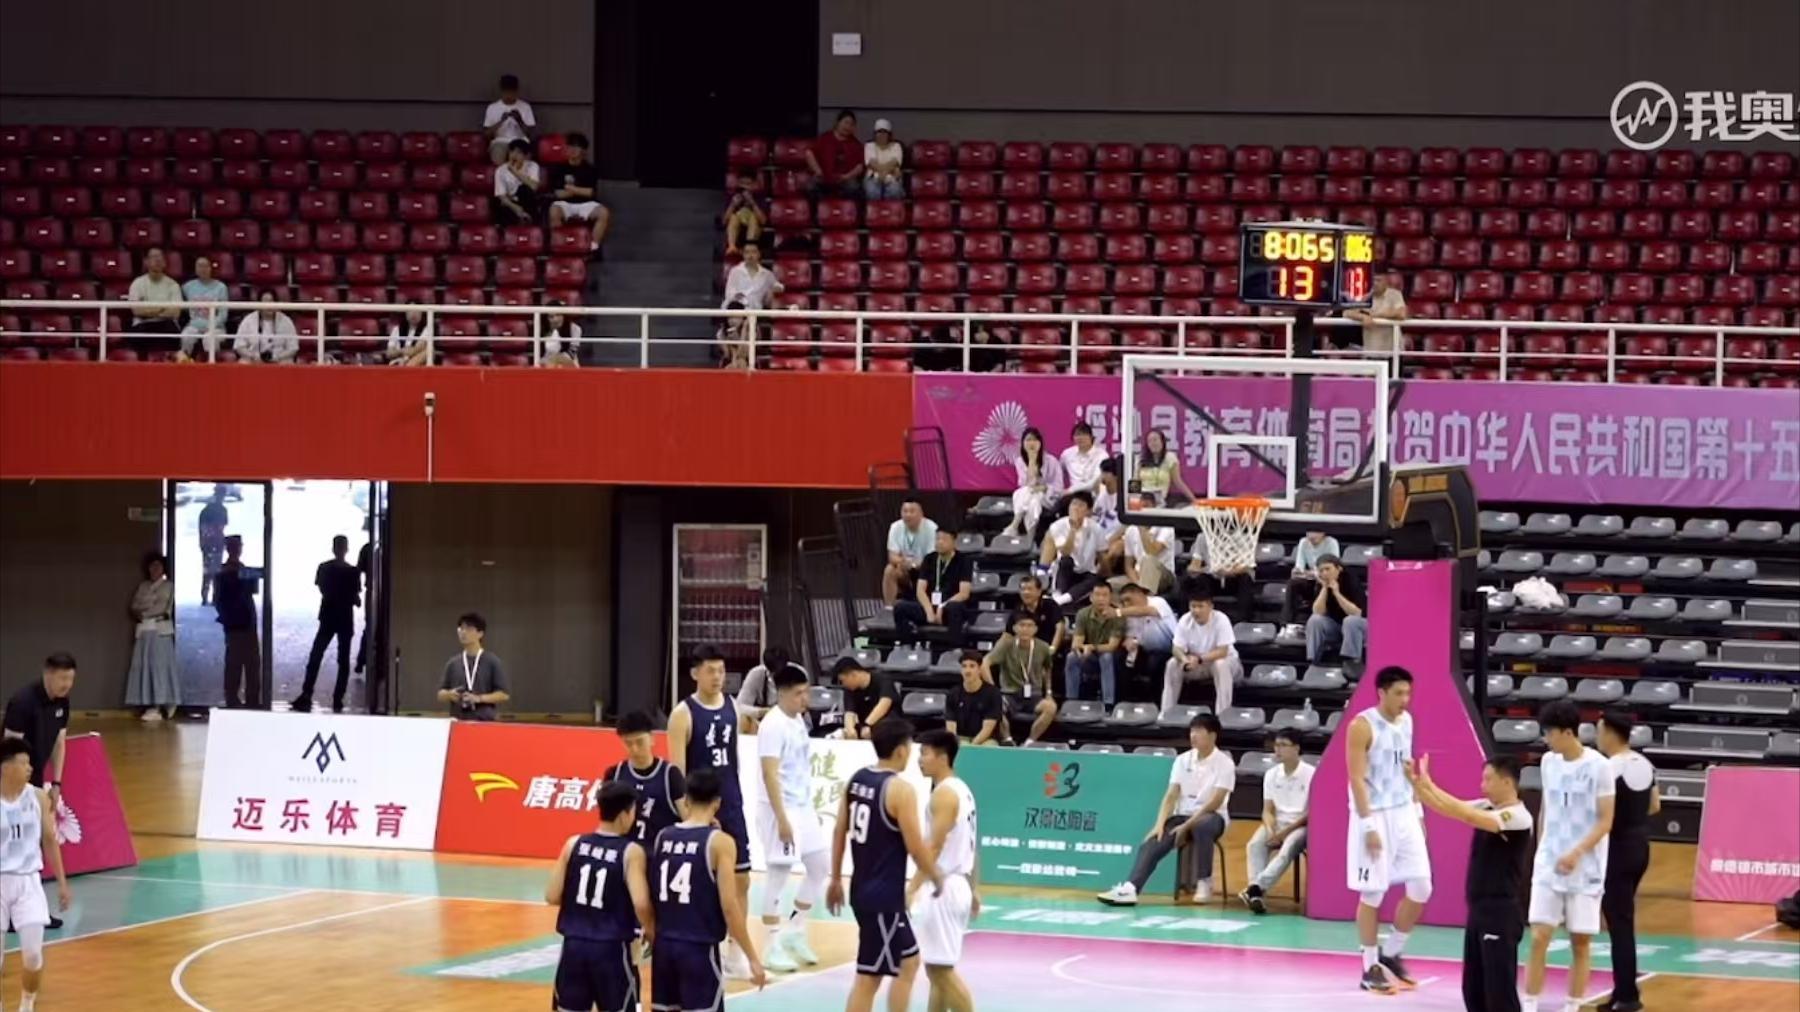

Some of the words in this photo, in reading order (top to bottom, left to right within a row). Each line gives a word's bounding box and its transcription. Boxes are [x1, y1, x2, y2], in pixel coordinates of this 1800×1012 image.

[1278, 265, 1314, 301] 13
[712, 748, 729, 767] 31
[232, 796, 407, 838] 迈乐体育
[576, 863, 608, 909] 11
[659, 860, 693, 904] 14
[1358, 868, 1370, 882] 14
